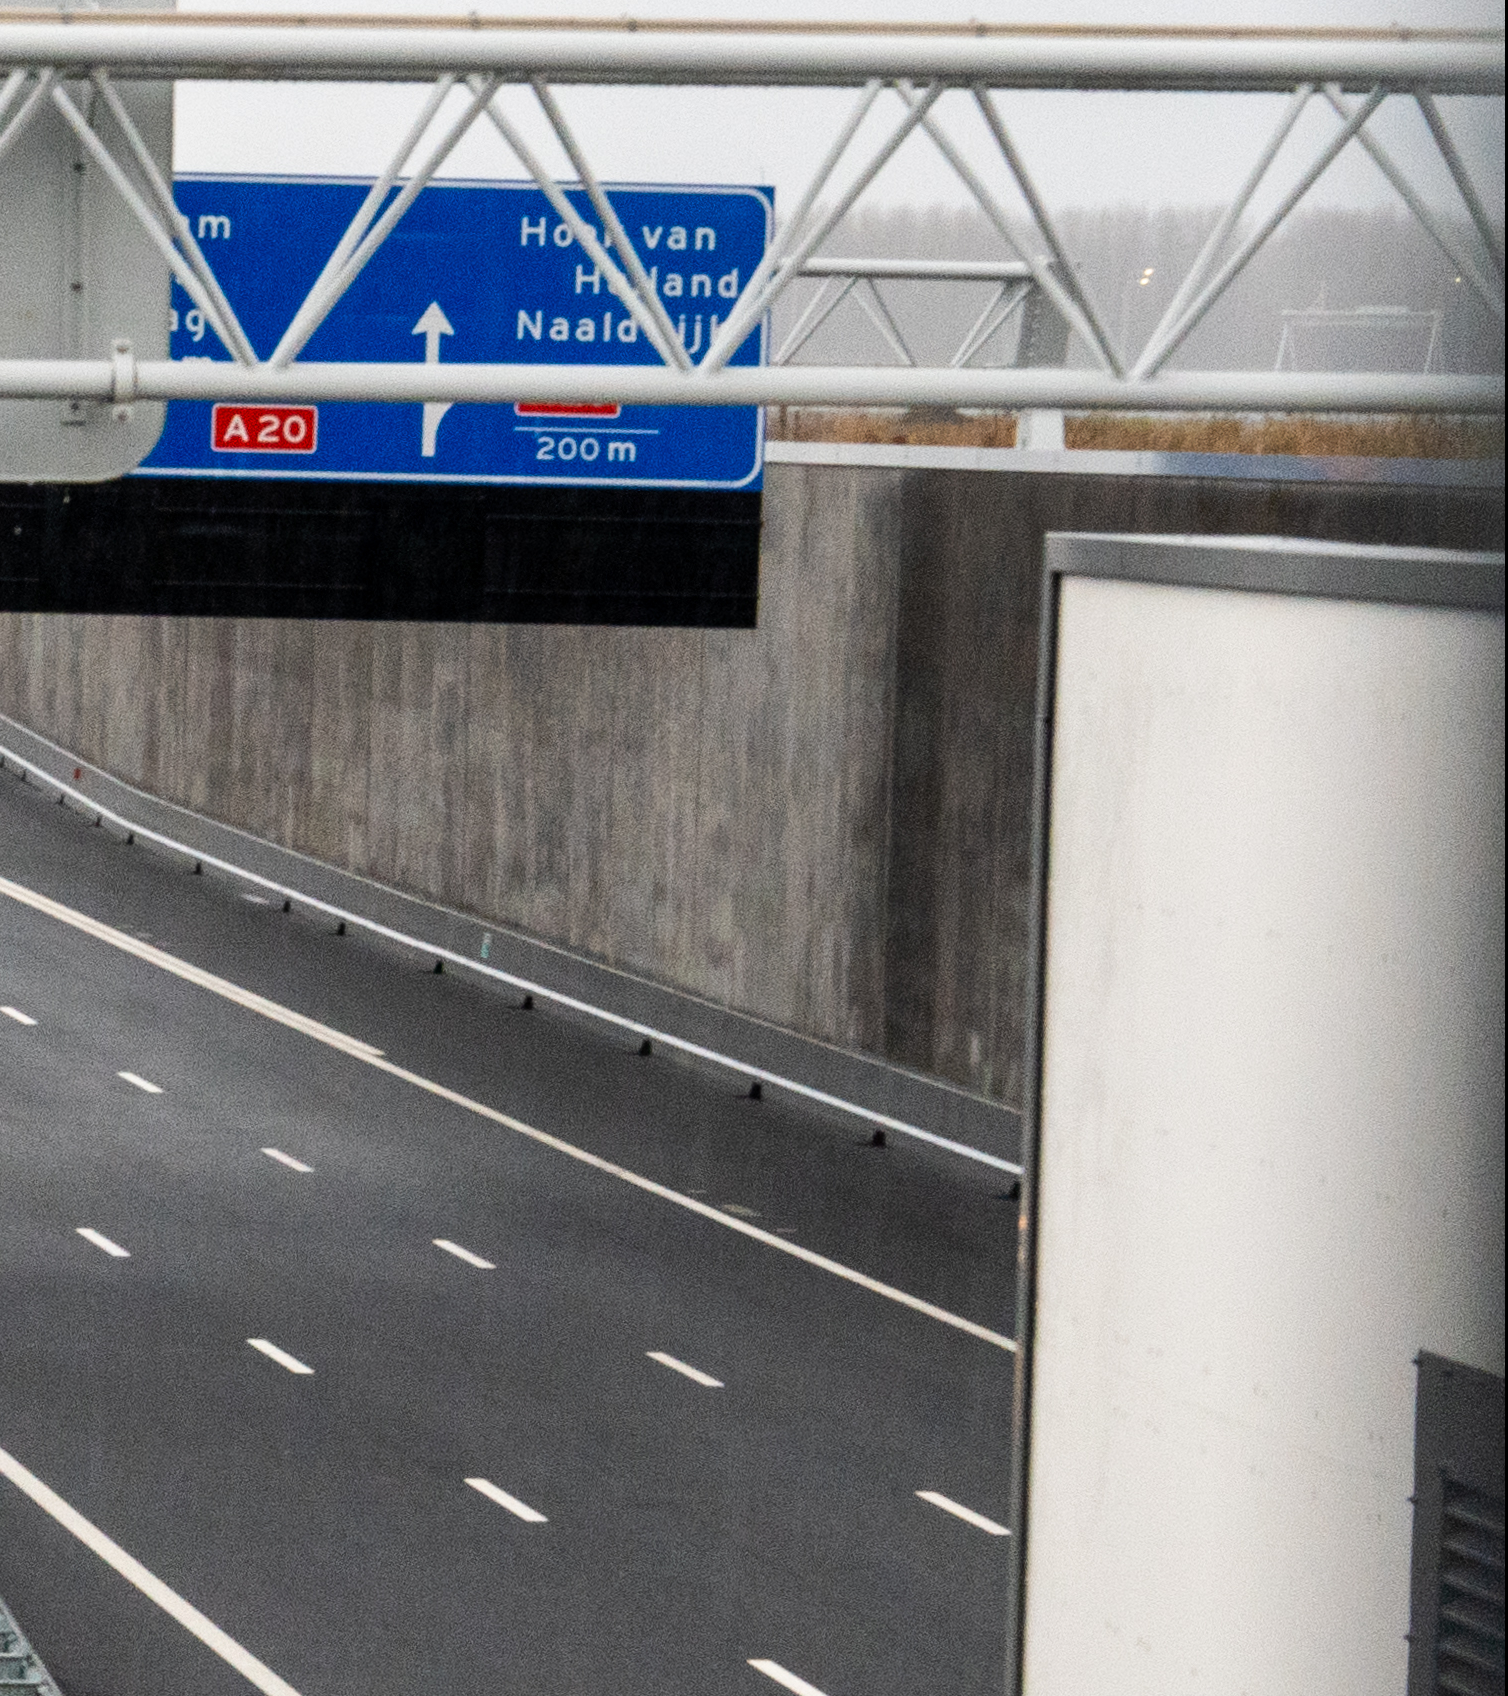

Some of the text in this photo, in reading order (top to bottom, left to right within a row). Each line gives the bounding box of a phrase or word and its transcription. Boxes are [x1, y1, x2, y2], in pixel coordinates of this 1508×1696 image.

[641, 224, 717, 251] van
[575, 264, 739, 299] Hland
[516, 309, 728, 354] Naaldij
[536, 437, 637, 462] 200 m
